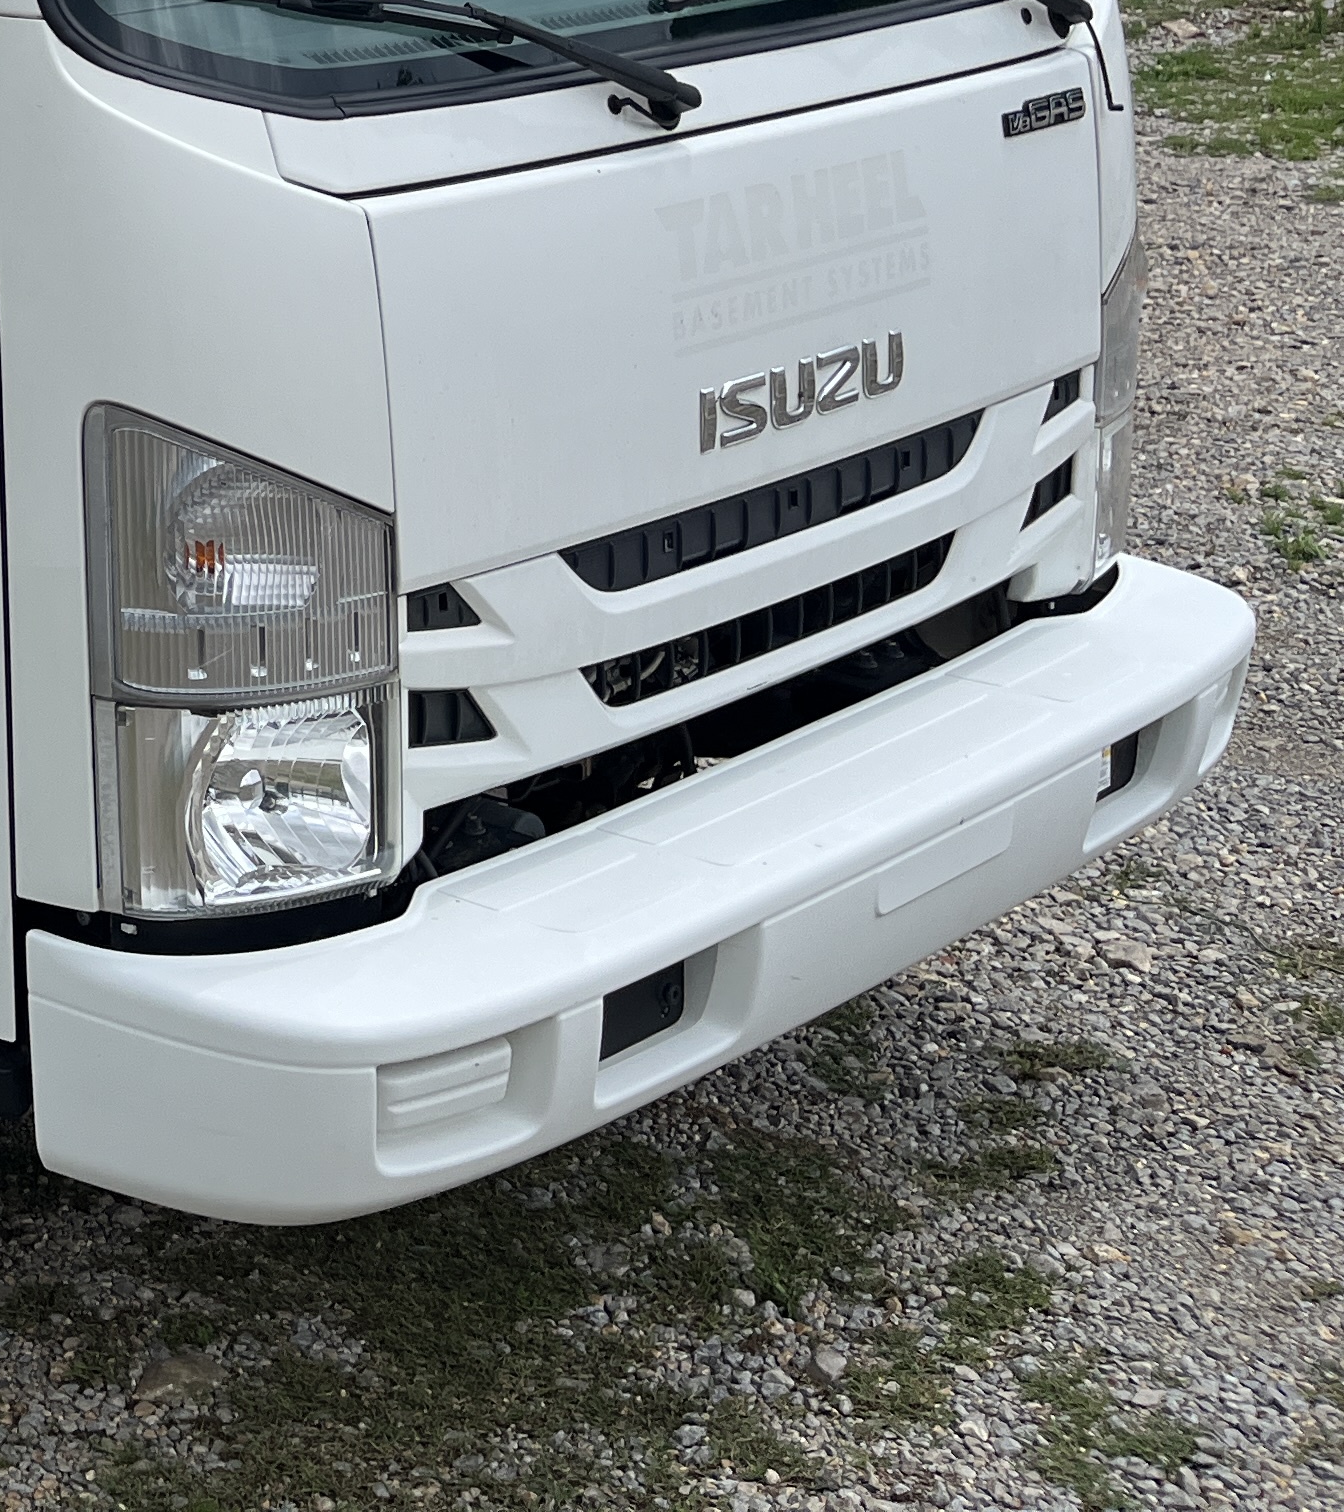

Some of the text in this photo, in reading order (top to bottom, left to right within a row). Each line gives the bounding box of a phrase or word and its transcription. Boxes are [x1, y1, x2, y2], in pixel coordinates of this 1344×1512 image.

[654, 149, 927, 281] TARHEEL
[672, 241, 930, 341] BASEMENT SYSTEMS
[700, 328, 904, 455] ISUZU
